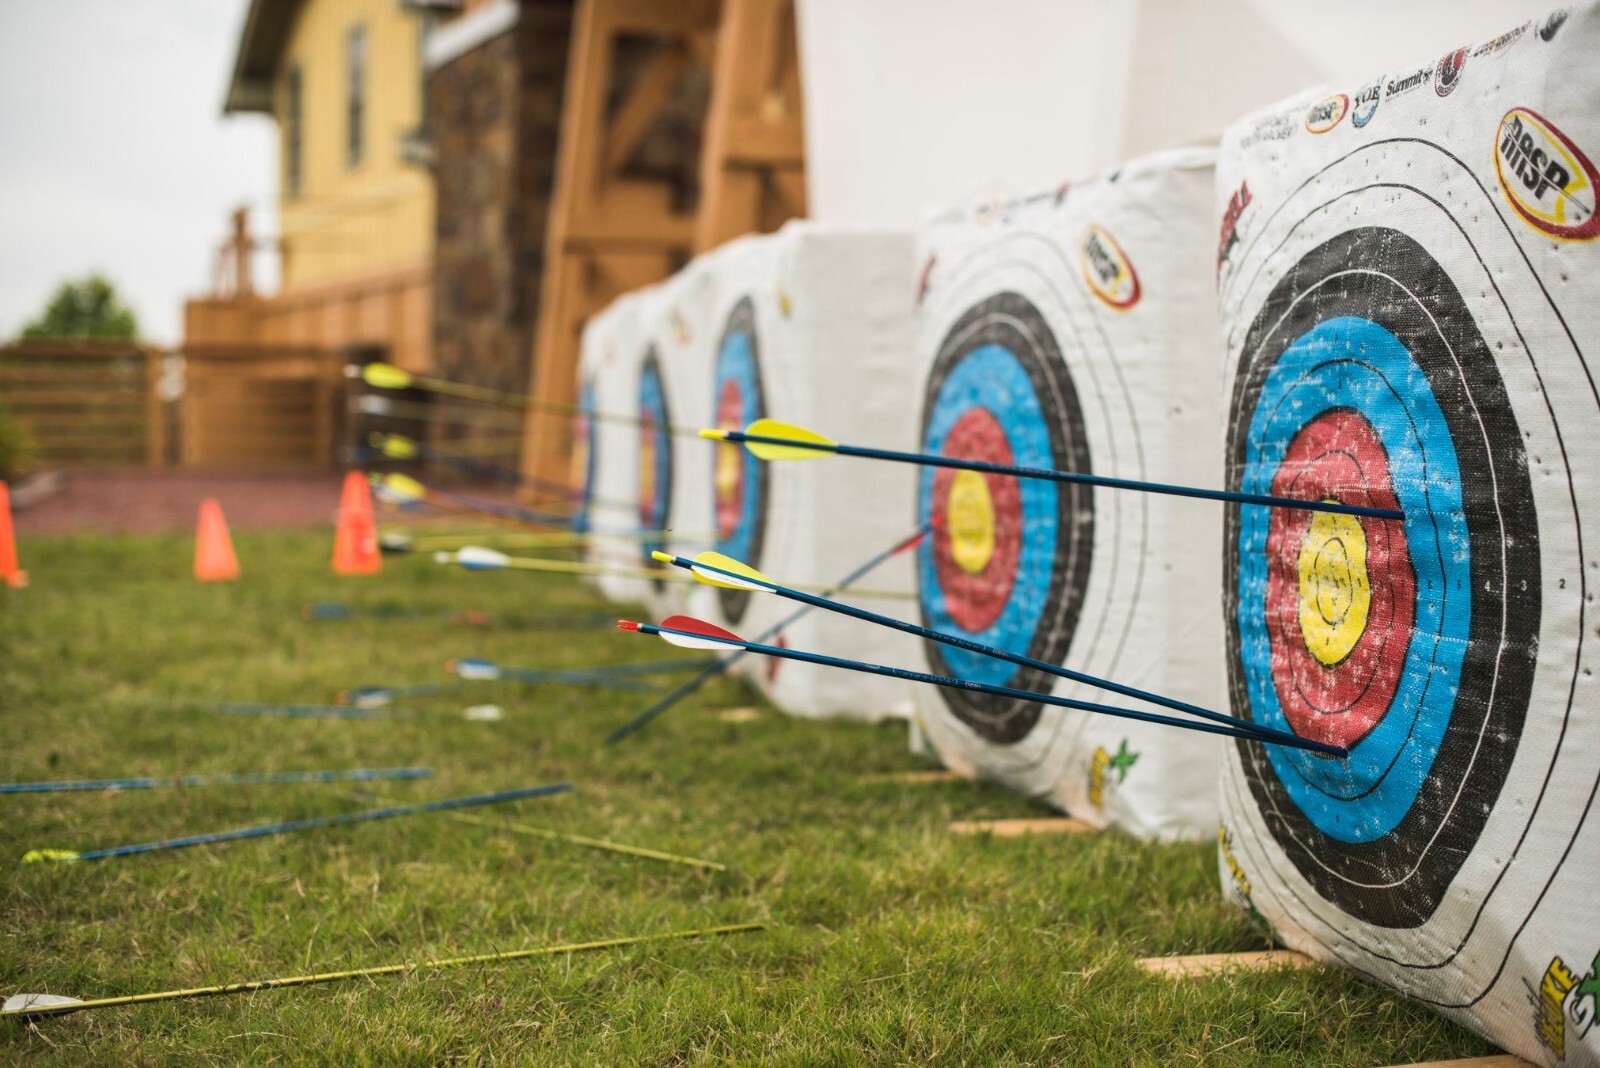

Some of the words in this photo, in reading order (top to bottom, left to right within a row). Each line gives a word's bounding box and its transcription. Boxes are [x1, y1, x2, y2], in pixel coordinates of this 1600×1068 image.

[1386, 69, 1423, 97] Summit
[1484, 580, 1491, 592] 4
[1520, 580, 1528, 591] 3
[1558, 578, 1566, 590] 2
